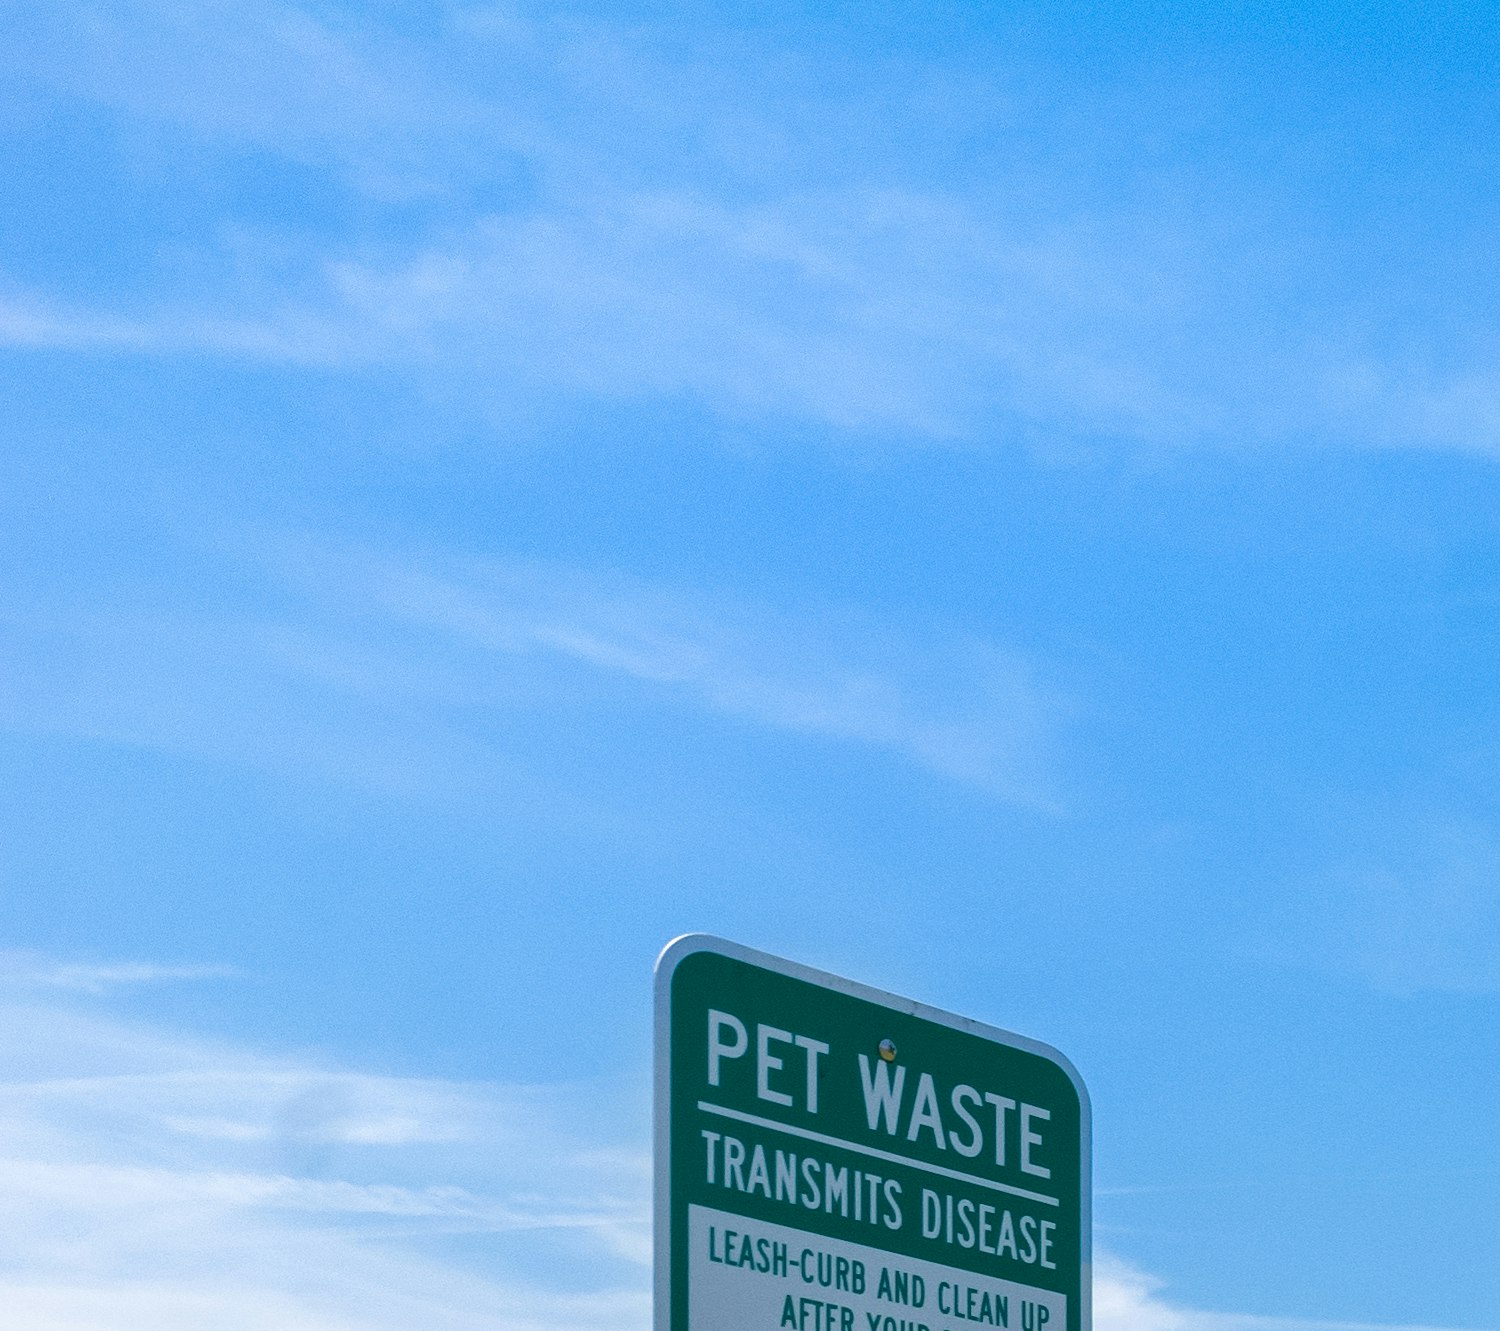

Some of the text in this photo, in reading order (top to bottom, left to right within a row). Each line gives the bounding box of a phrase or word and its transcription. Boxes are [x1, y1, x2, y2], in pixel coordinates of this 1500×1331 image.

[707, 1008, 1051, 1180] PET WASTE
[701, 1129, 1057, 1270] TRANSMITS DISEASE
[709, 1226, 866, 1295] LEASH-CURB
[877, 1267, 926, 1308] AND
[938, 1281, 1008, 1329] CLEAN
